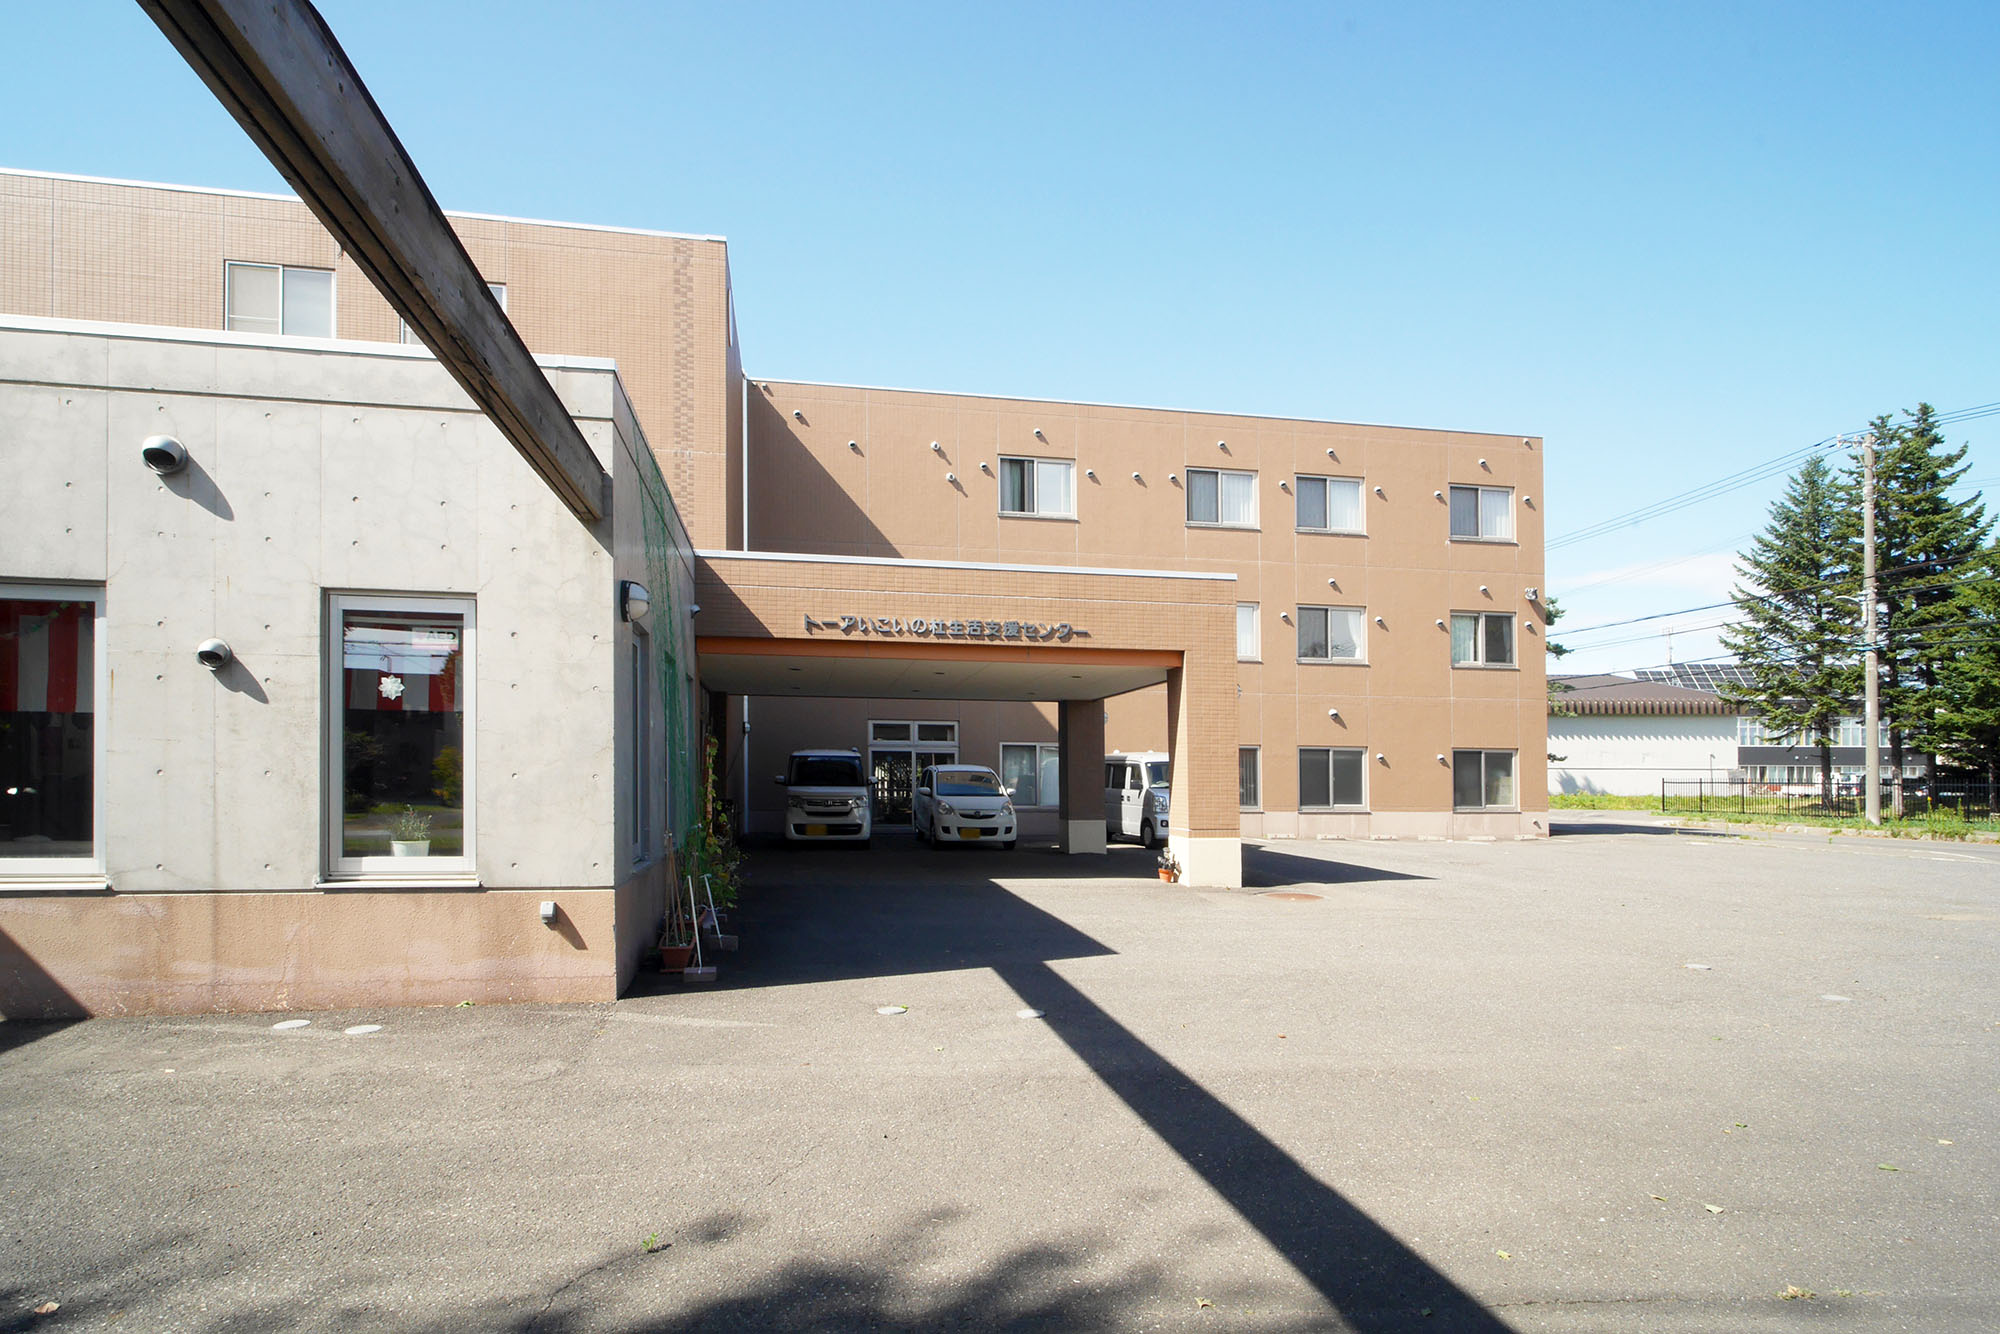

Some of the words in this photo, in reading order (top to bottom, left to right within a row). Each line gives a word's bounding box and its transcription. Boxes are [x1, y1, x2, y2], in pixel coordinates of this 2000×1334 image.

[426, 630, 457, 640] AED
[804, 613, 1089, 640] トーアいこいの杜生活支援センター
